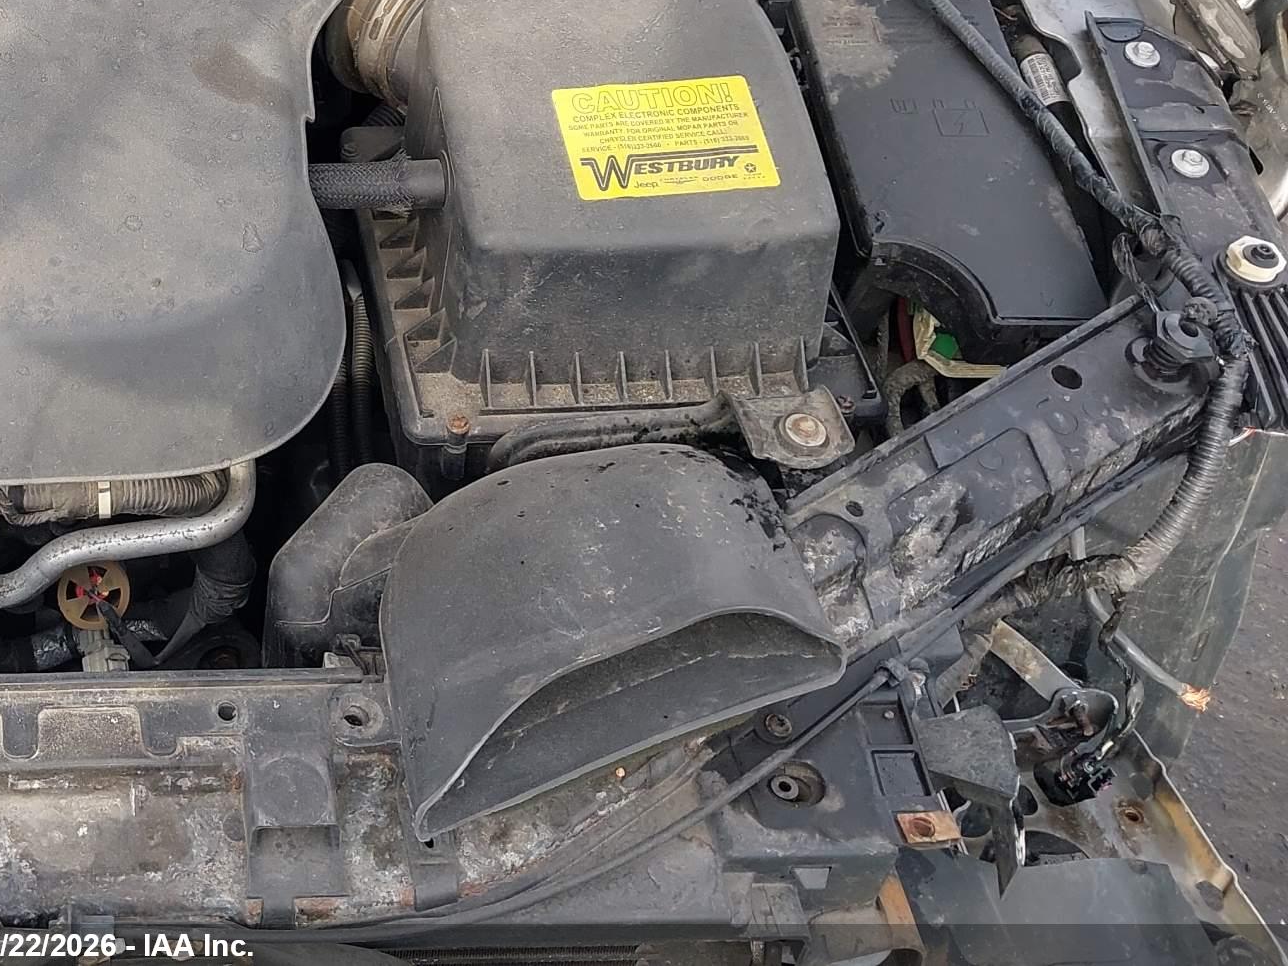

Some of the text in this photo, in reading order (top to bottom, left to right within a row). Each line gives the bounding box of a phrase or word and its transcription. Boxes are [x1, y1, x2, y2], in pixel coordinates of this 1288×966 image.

[572, 83, 733, 114] CAUTION!
[573, 103, 740, 123] COMPLEX ELECTRONIC COMPONENTS
[631, 118, 664, 126] COVERED
[692, 112, 748, 122] MANUFACTURER
[600, 136, 637, 144] CHRYSLER
[675, 131, 705, 139] SERVICE
[643, 126, 676, 134] ORIGINAL
[580, 154, 741, 191] WESTBURY
